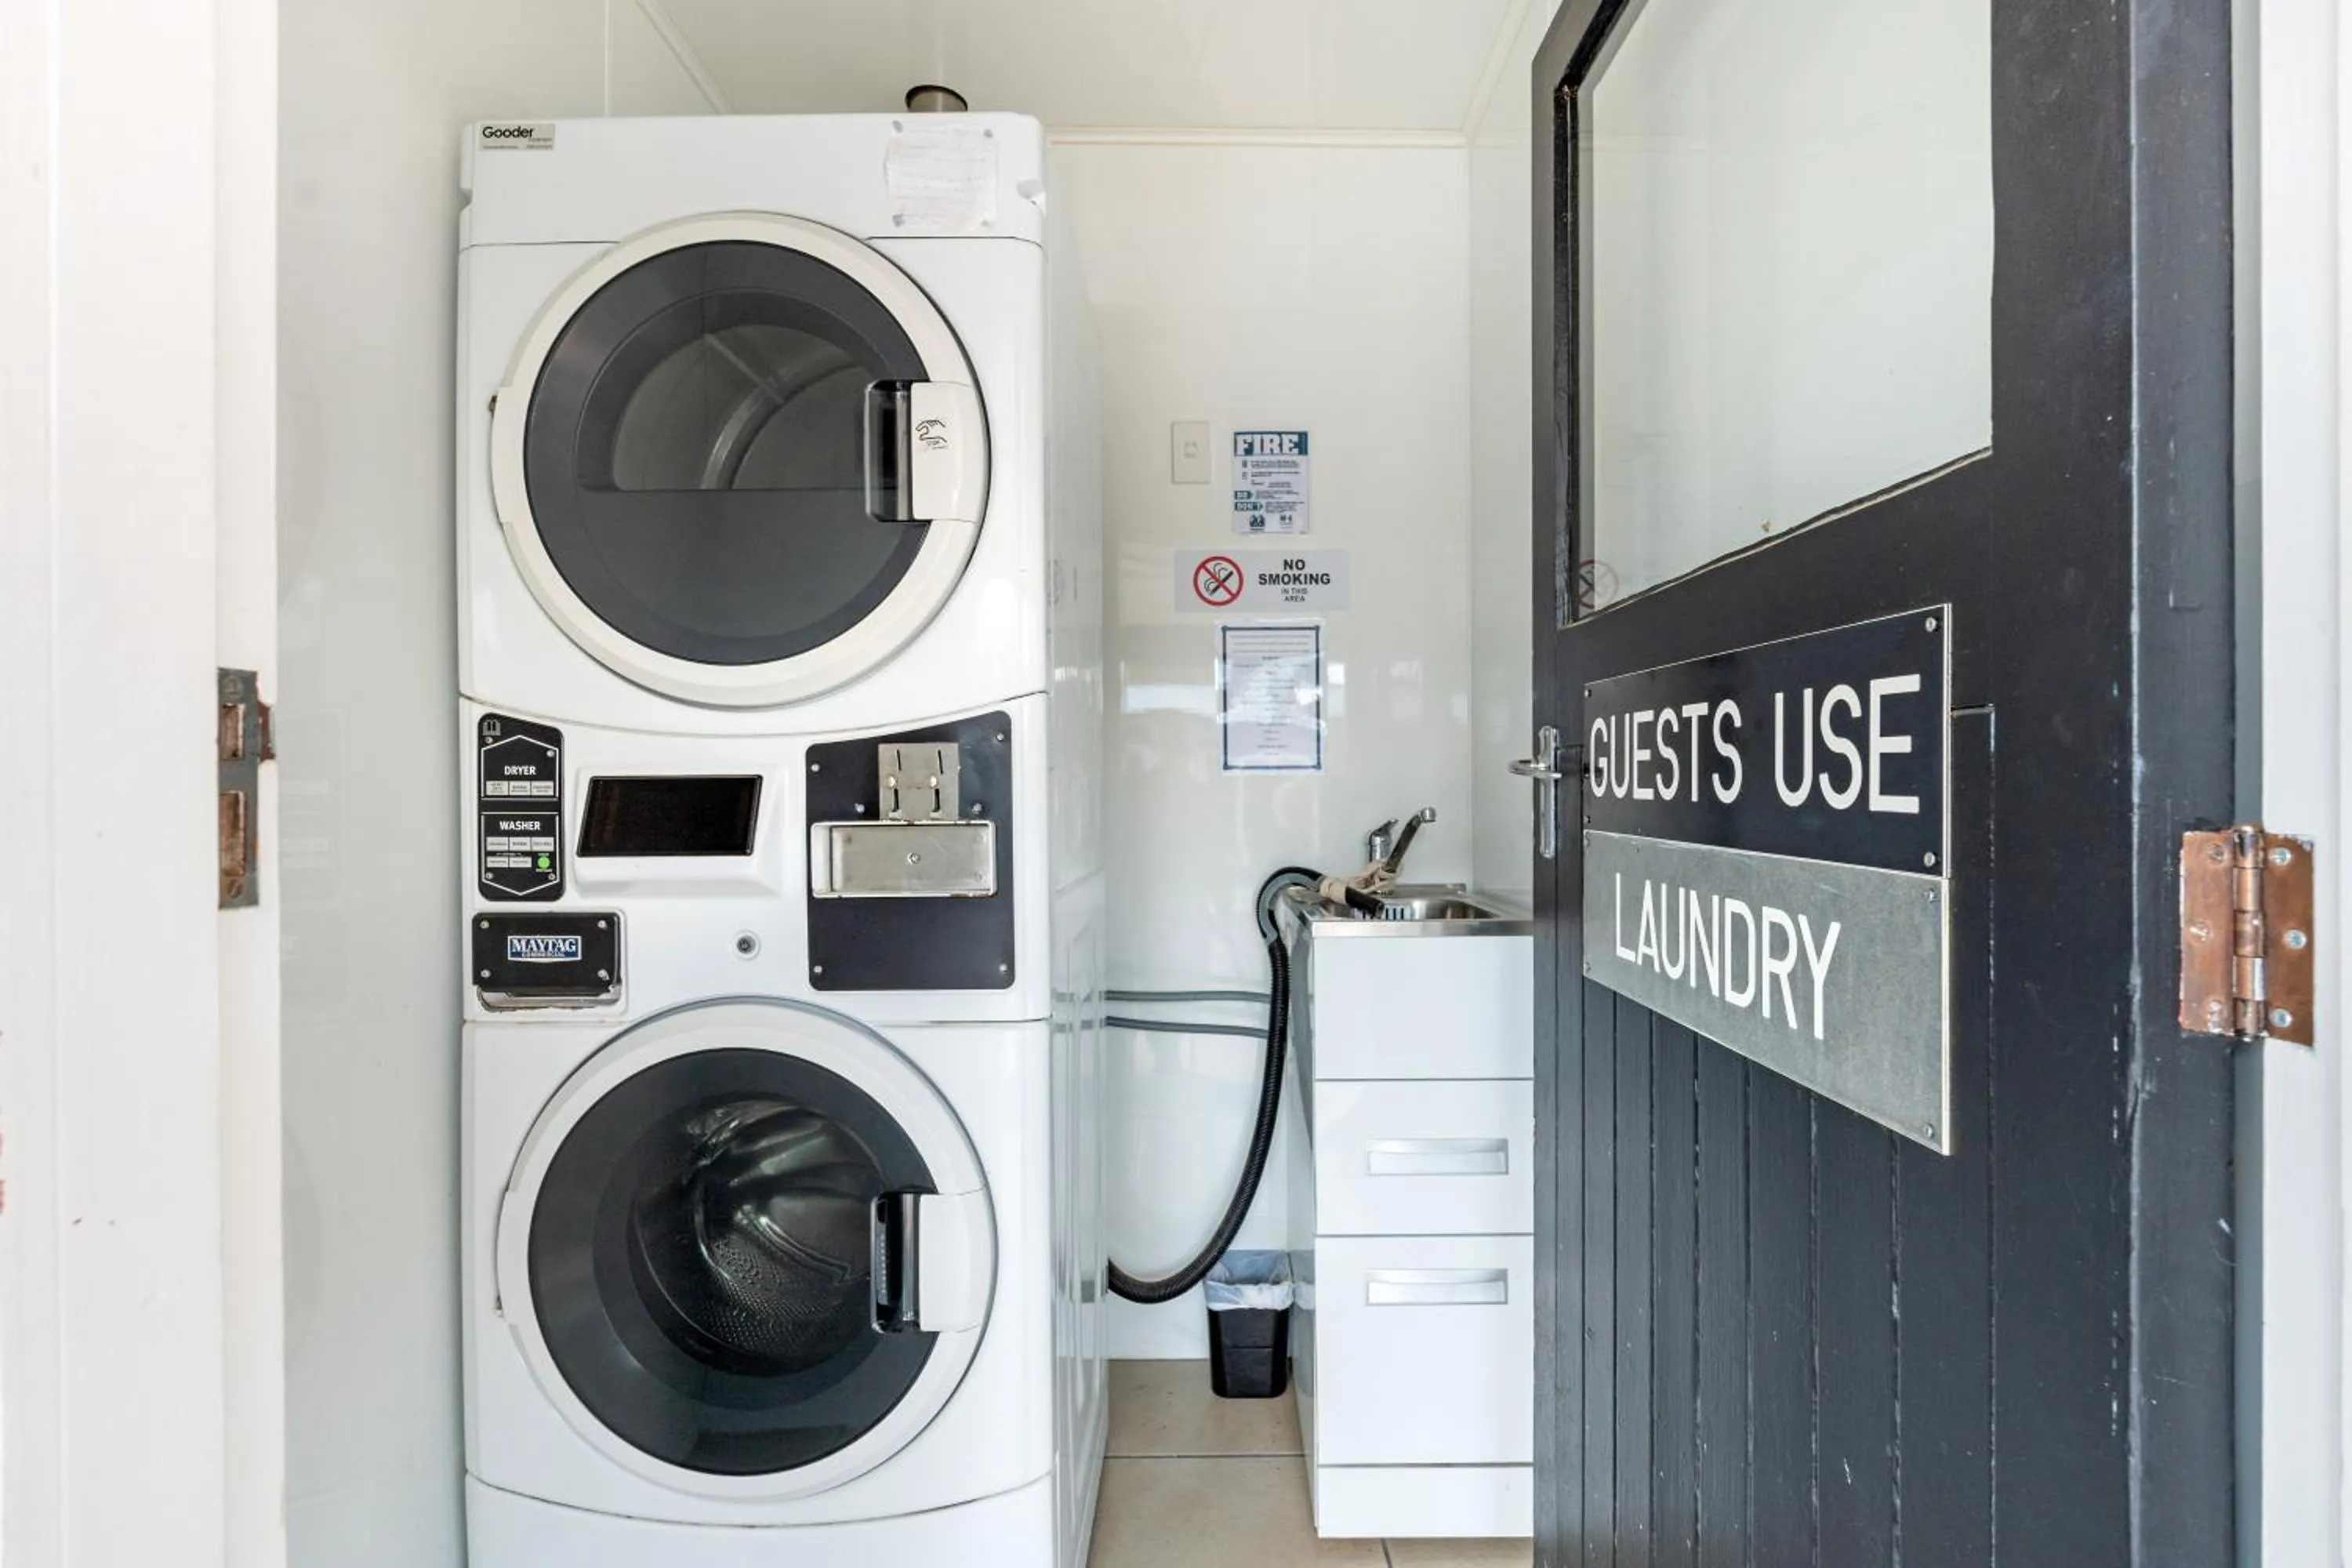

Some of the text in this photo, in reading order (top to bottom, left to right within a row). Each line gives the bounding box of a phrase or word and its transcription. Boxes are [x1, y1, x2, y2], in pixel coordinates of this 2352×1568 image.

[483, 126, 534, 139] Gooder
[1236, 434, 1299, 455] FIRE
[1283, 559, 1305, 571] NO
[1258, 573, 1330, 586] SMOKING
[1588, 673, 1921, 815] GUESTS USE
[504, 765, 536, 775] DRYER
[499, 821, 541, 830] WASHER
[511, 938, 577, 953] MAYTAG
[1615, 873, 1842, 1041] LAUNDRY
